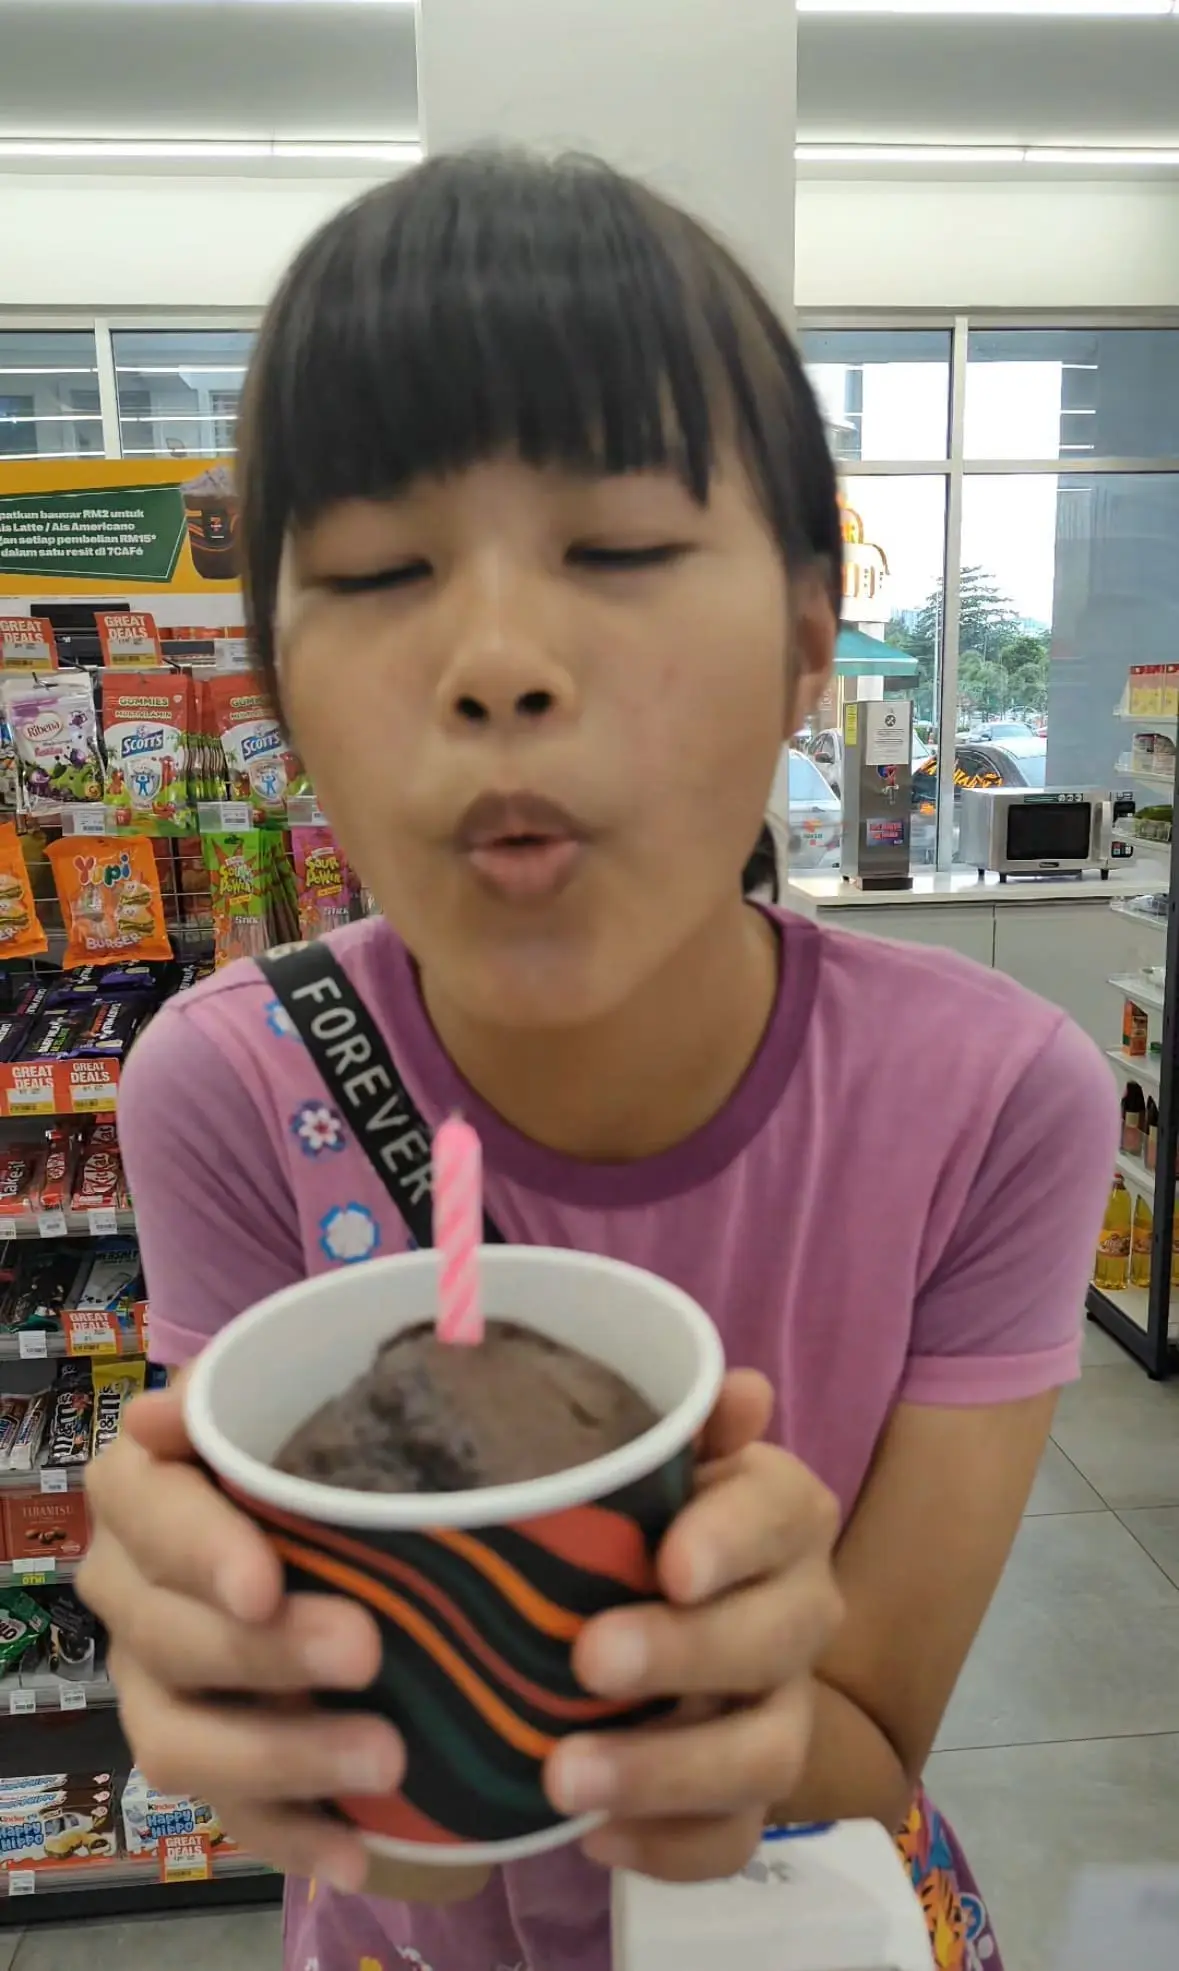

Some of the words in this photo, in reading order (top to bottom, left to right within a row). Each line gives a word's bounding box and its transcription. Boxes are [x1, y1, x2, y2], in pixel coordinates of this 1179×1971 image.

[40, 510, 82, 519] baucar
[83, 509, 109, 518] RM2
[110, 509, 145, 518] untuk
[13, 523, 43, 533] Latte
[51, 522, 71, 532] Ais
[72, 522, 136, 532] Americano
[19, 535, 56, 546] setiap
[57, 534, 119, 546] pembelian
[1, 548, 38, 557] dalam
[39, 547, 65, 557] satu
[66, 546, 94, 556] resit
[95, 546, 107, 556] di
[104, 615, 145, 627] GREAT
[3, 632, 44, 643] DEALS
[108, 627, 148, 638] DEALS
[119, 696, 169, 706] GUMMIES
[27, 718, 61, 737] Ribena
[73, 850, 132, 887] Yupi
[85, 933, 142, 949] BURGER
[12, 1065, 54, 1078] GREAT
[73, 1062, 105, 1072] GREAT
[70, 1071, 110, 1083] DEALS
[15, 1077, 54, 1089] DEALS
[291, 976, 435, 1206] FOREVER
[69, 1312, 109, 1322] GREAT
[73, 1321, 110, 1331] DEALS
[166, 1836, 202, 1846] GREAT
[167, 1845, 203, 1857] DEALS
